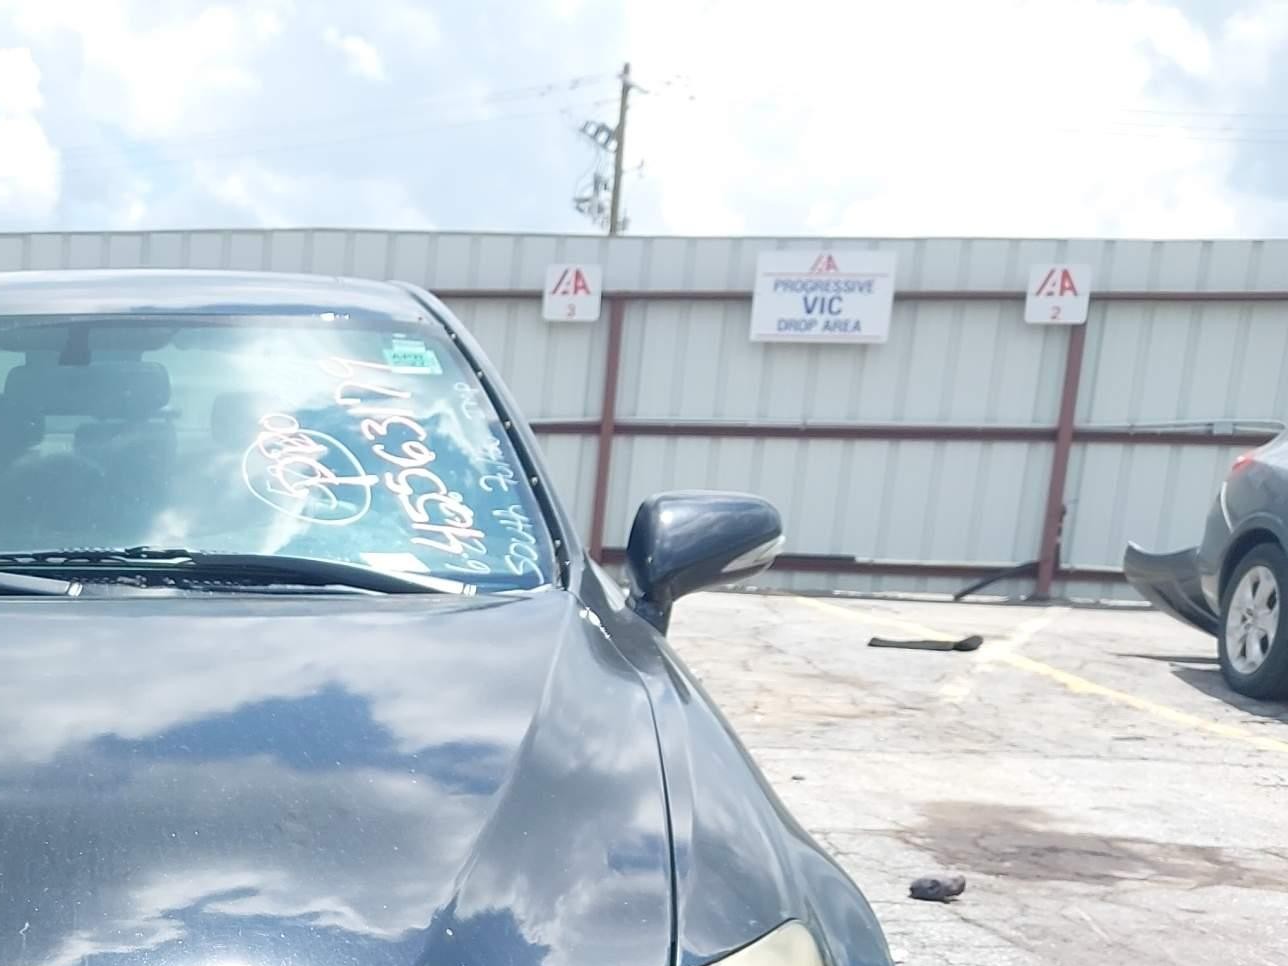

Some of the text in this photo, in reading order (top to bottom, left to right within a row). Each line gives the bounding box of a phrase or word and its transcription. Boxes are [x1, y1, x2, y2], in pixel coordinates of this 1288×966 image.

[773, 278, 875, 294] PROGRESSIVE
[567, 303, 577, 317] 3
[802, 296, 843, 315] VIC
[1050, 305, 1062, 320] 2
[777, 319, 861, 332] DROP AREA
[318, 356, 486, 554] 45563179
